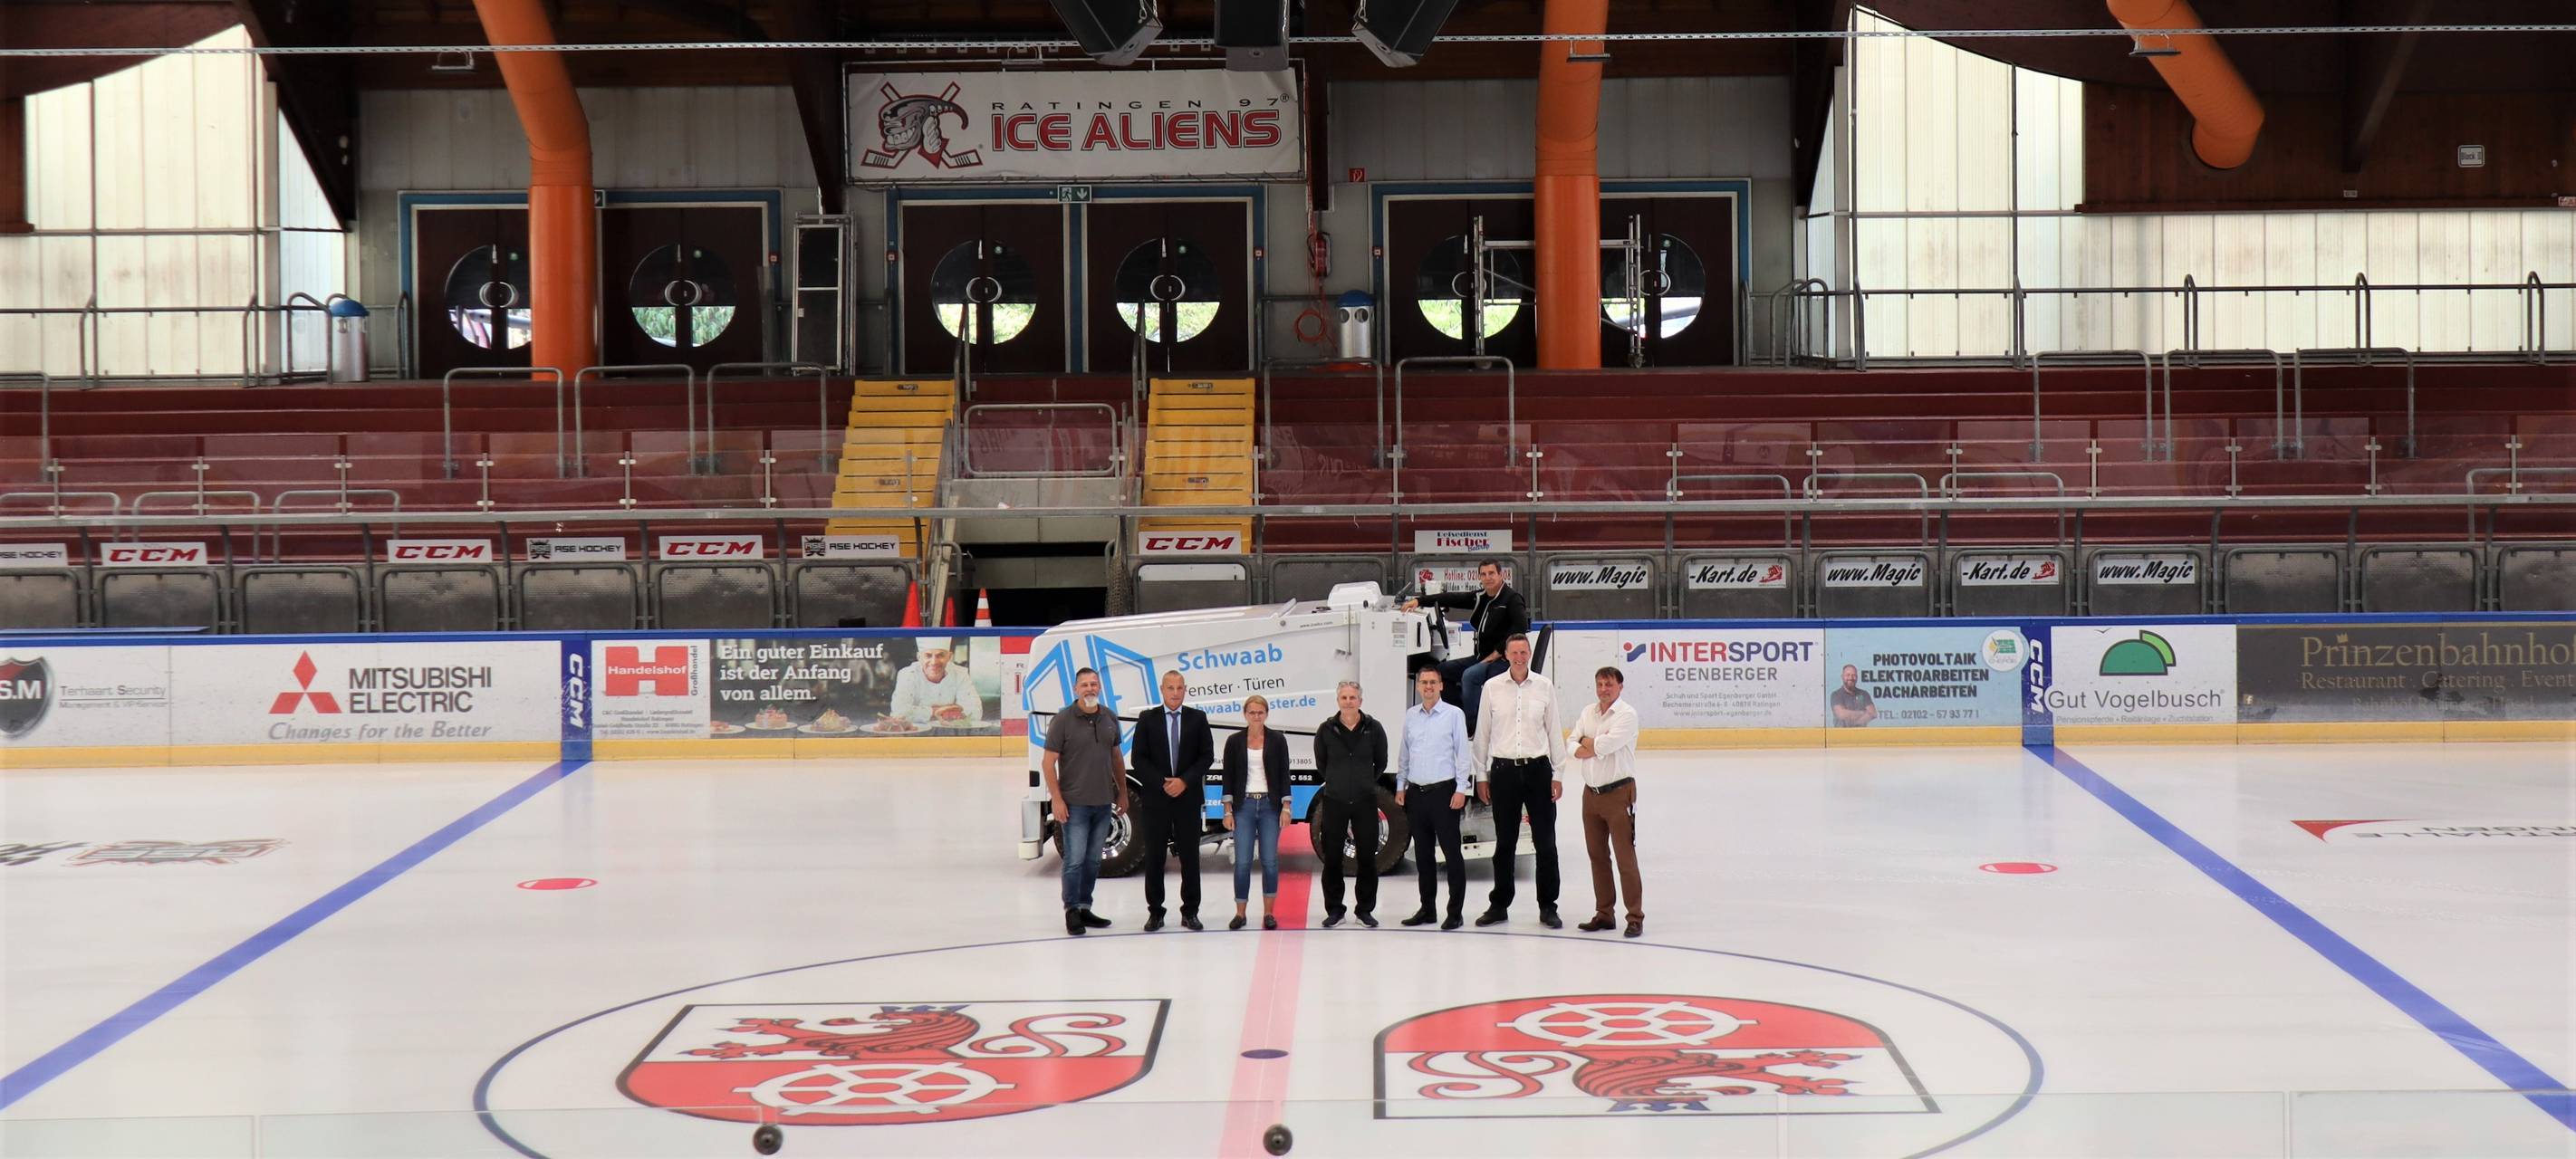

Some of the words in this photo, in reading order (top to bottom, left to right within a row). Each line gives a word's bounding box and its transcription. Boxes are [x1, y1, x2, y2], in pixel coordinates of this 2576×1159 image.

[992, 100, 1202, 110] RATINGEN
[991, 112, 1072, 151] ICE
[1081, 110, 1282, 151] ALIENS
[579, 544, 622, 552] HOCKEY
[667, 541, 756, 555] CCM
[1145, 537, 1235, 551] CCM
[1437, 538, 1489, 546] Fischer
[110, 549, 199, 562] CCM
[395, 546, 485, 559] CCM
[1444, 569, 1466, 580] Hotline:
[1552, 566, 1646, 588] www.Magic
[1689, 564, 1757, 584] -Kart.de
[1827, 563, 1921, 586] www.Magic
[1963, 561, 2030, 580] -Kart.de
[2099, 560, 2193, 583] www.Magic
[720, 645, 753, 660] Ein
[757, 646, 805, 663] guter
[809, 644, 883, 659] Einkauf
[1177, 643, 1283, 672] Schwaab
[1650, 641, 1813, 662] INTERSPORT
[1873, 653, 1976, 666] PHOTOVOLTAIK
[349, 666, 492, 689] MITSUBISHI
[608, 666, 687, 675] Handelshof
[720, 665, 743, 680] ist
[749, 665, 778, 680] der
[784, 665, 851, 683] Anfang
[1665, 667, 1777, 681] EGENBERGER
[1861, 669, 1989, 682] ELEKTROARBEITEN
[2030, 638, 2043, 714] CCM
[118, 685, 166, 696] Security
[570, 653, 583, 728] CCM
[1187, 683, 1233, 696] enster
[1244, 677, 1284, 691] Türen
[1873, 685, 1977, 698] DACHARBEITEN
[2301, 673, 2407, 689] Restaurant
[2421, 671, 2506, 694] Catering
[349, 691, 473, 714] ELECTRIC
[720, 689, 755, 701] von
[760, 685, 817, 701] allem.
[2048, 691, 2086, 708] Gut
[2095, 689, 2221, 713] Vogelbusch
[268, 722, 351, 742] Changes
[358, 723, 388, 741] for
[394, 723, 424, 738] the
[431, 720, 492, 738] Better
